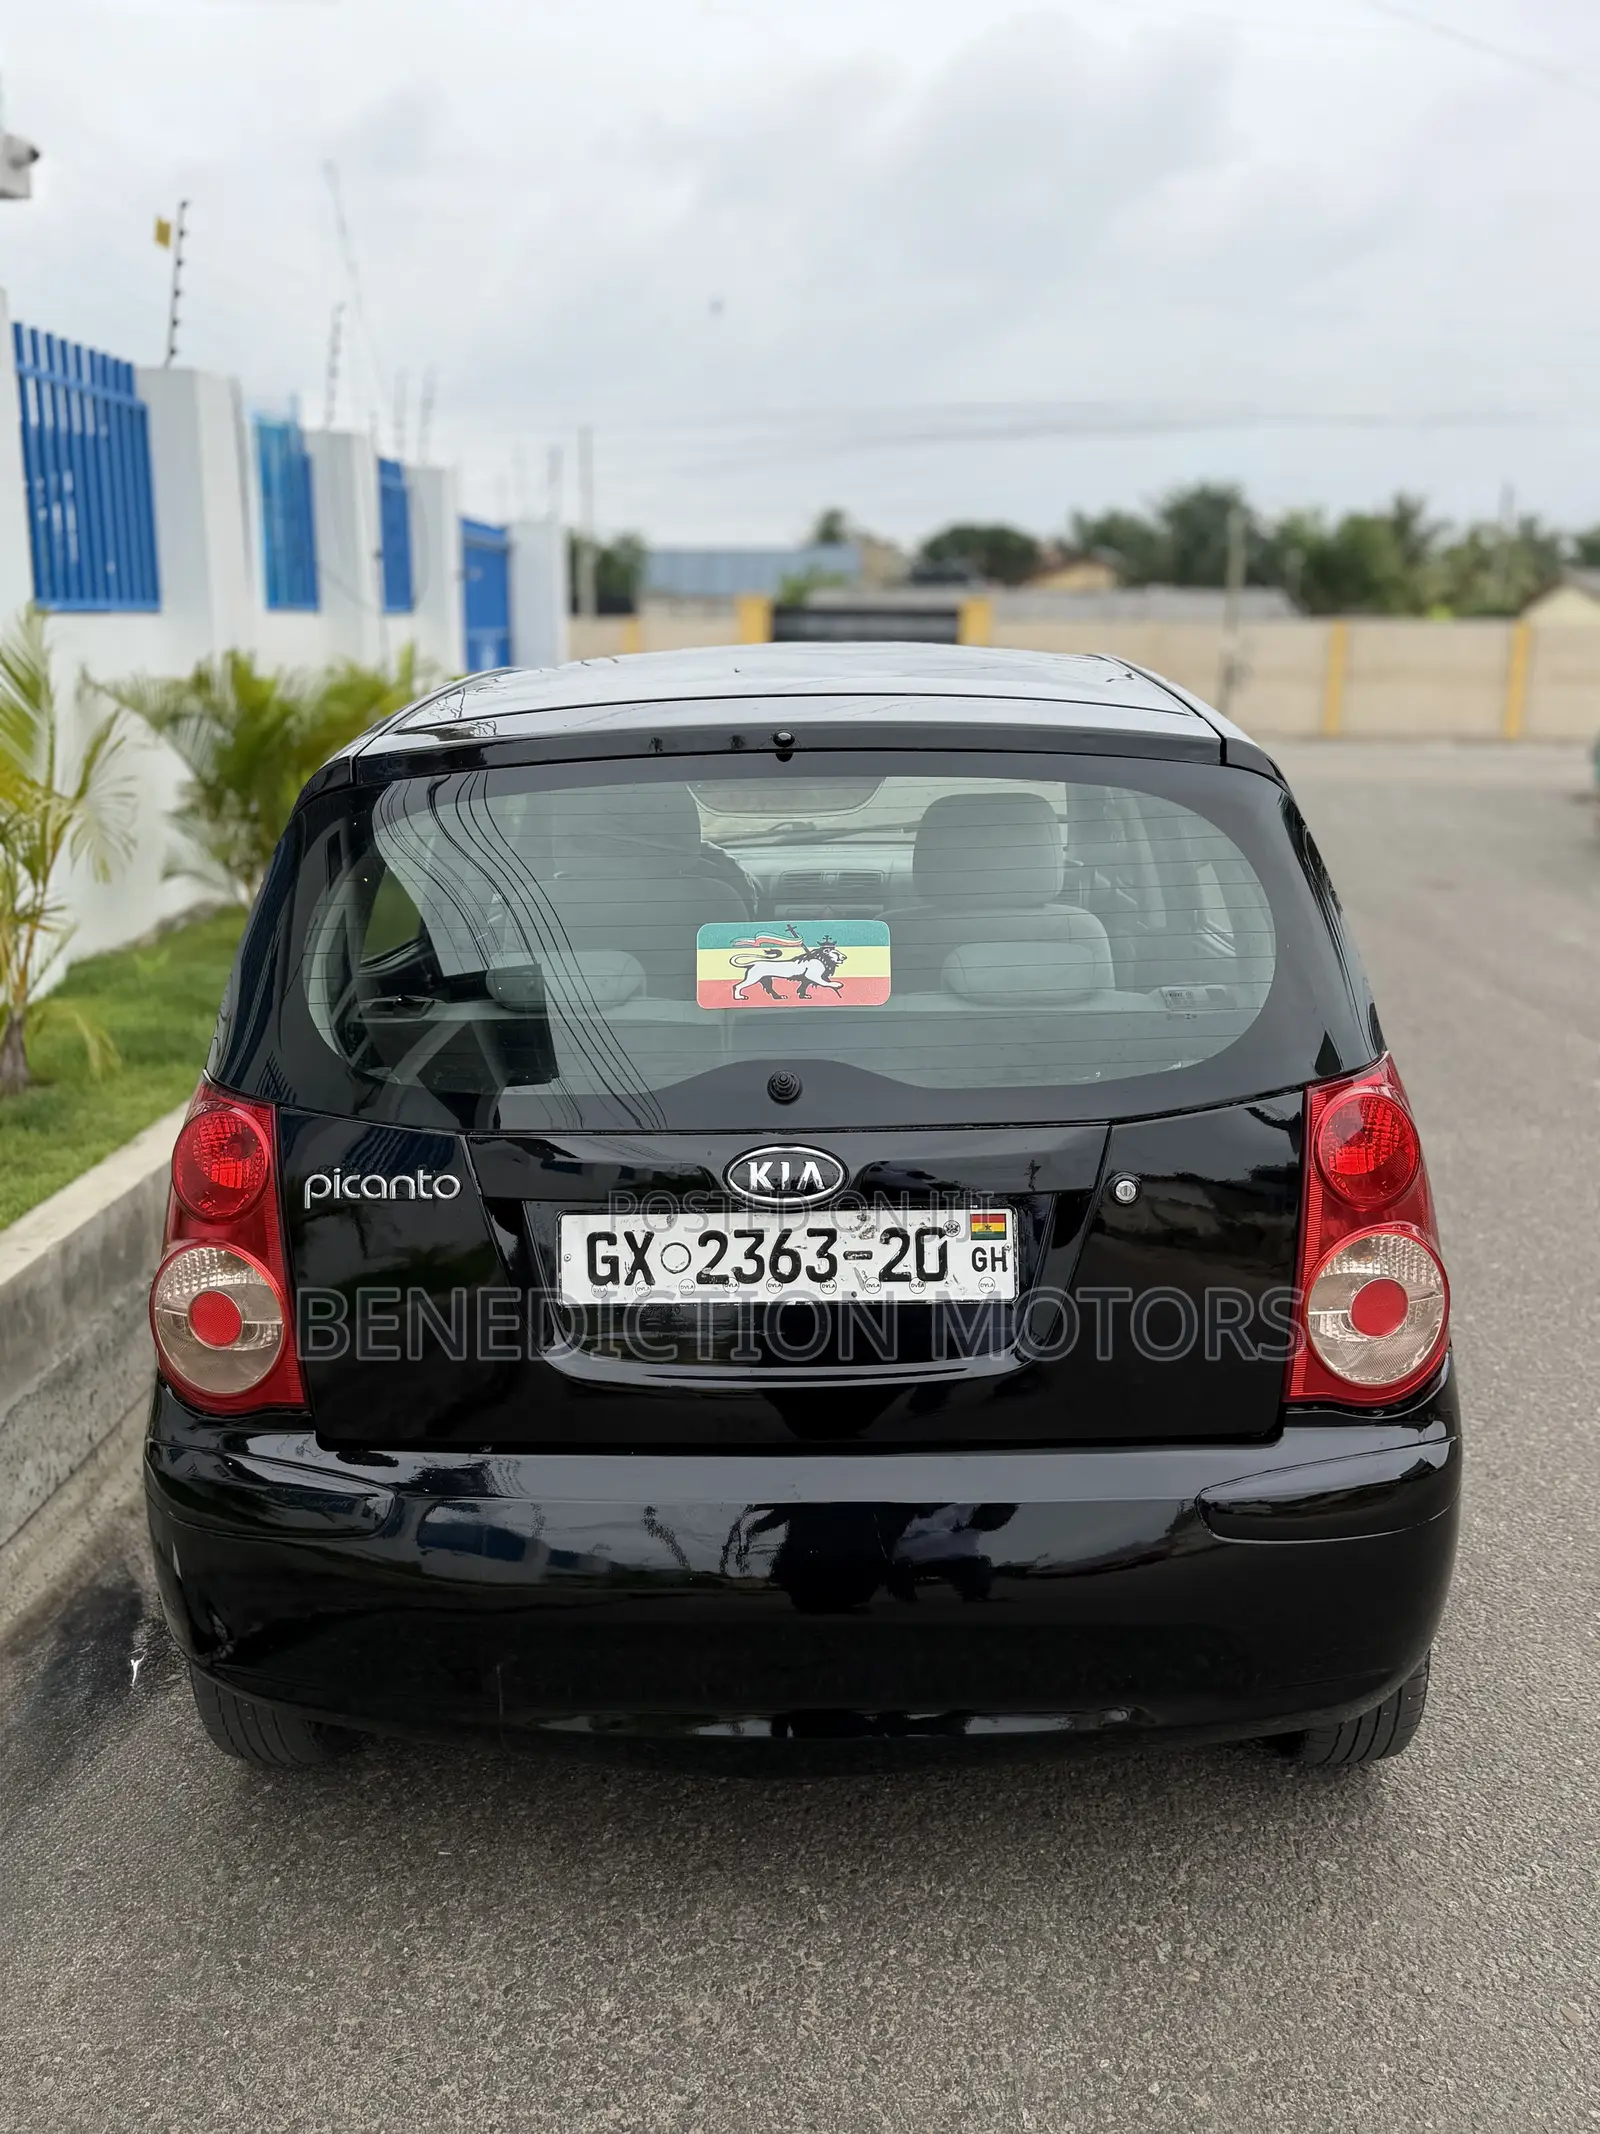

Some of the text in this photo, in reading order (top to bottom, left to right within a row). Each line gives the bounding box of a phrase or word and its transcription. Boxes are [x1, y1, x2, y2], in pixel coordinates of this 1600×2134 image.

[304, 1167, 461, 1209] picanto
[747, 1161, 825, 1190] KIA
[587, 1227, 948, 1286] GX 2363-20
[971, 1246, 1008, 1272] GH
